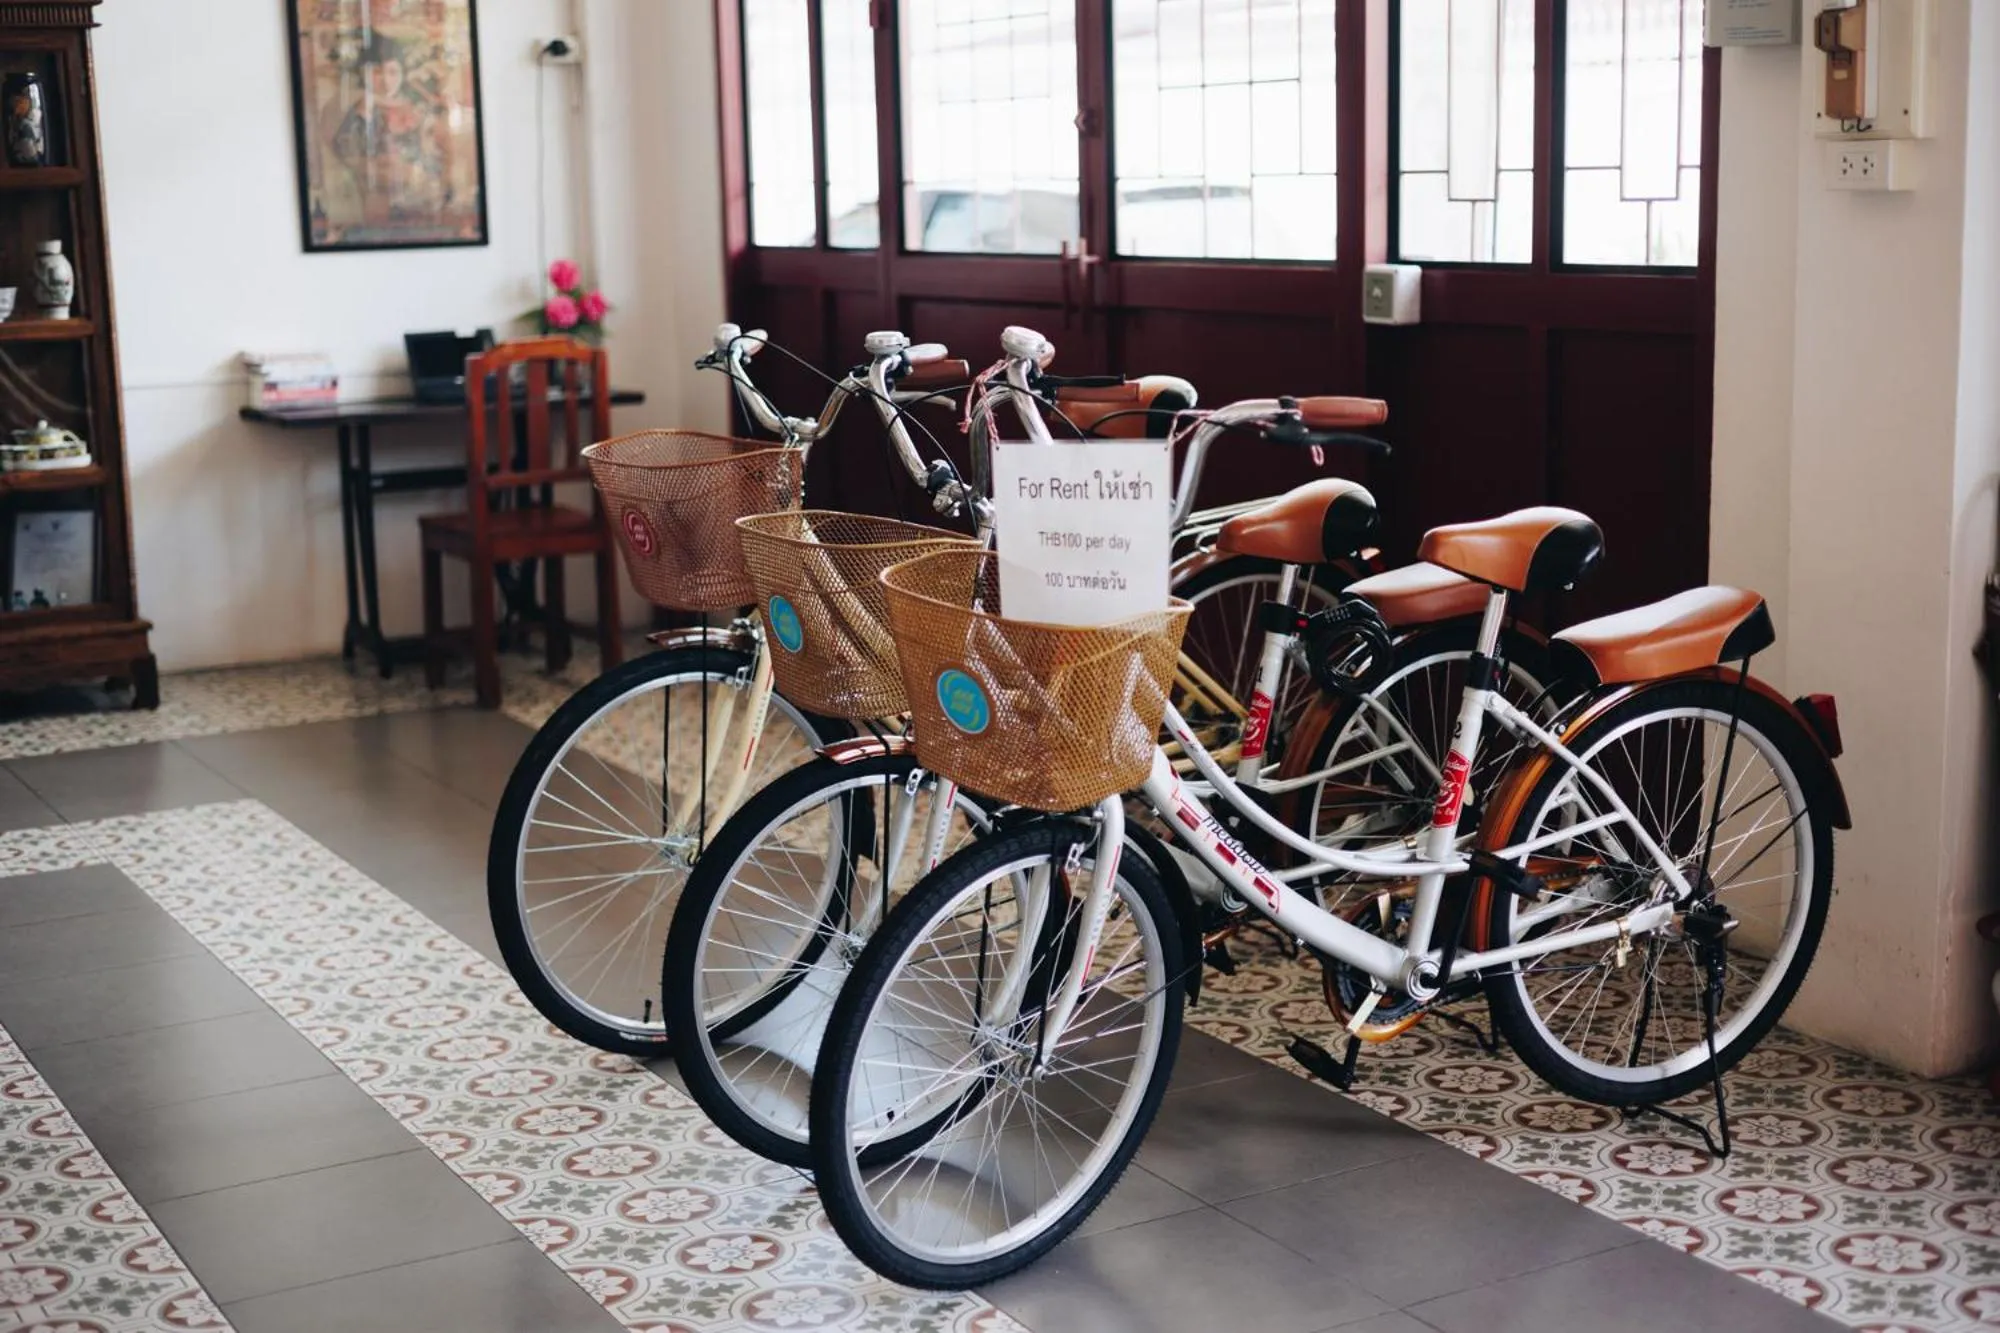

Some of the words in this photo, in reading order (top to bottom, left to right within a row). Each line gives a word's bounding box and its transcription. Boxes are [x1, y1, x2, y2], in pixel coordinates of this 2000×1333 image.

[1018, 477, 1043, 499] For
[1051, 477, 1089, 499] Rent
[1094, 470, 1153, 500] ให้เช่า
[1038, 531, 1082, 549] THB100
[1086, 535, 1104, 551] per
[1108, 534, 1131, 553] day
[1045, 572, 1063, 588] 100
[1066, 571, 1127, 591] บาทต่อวัน
